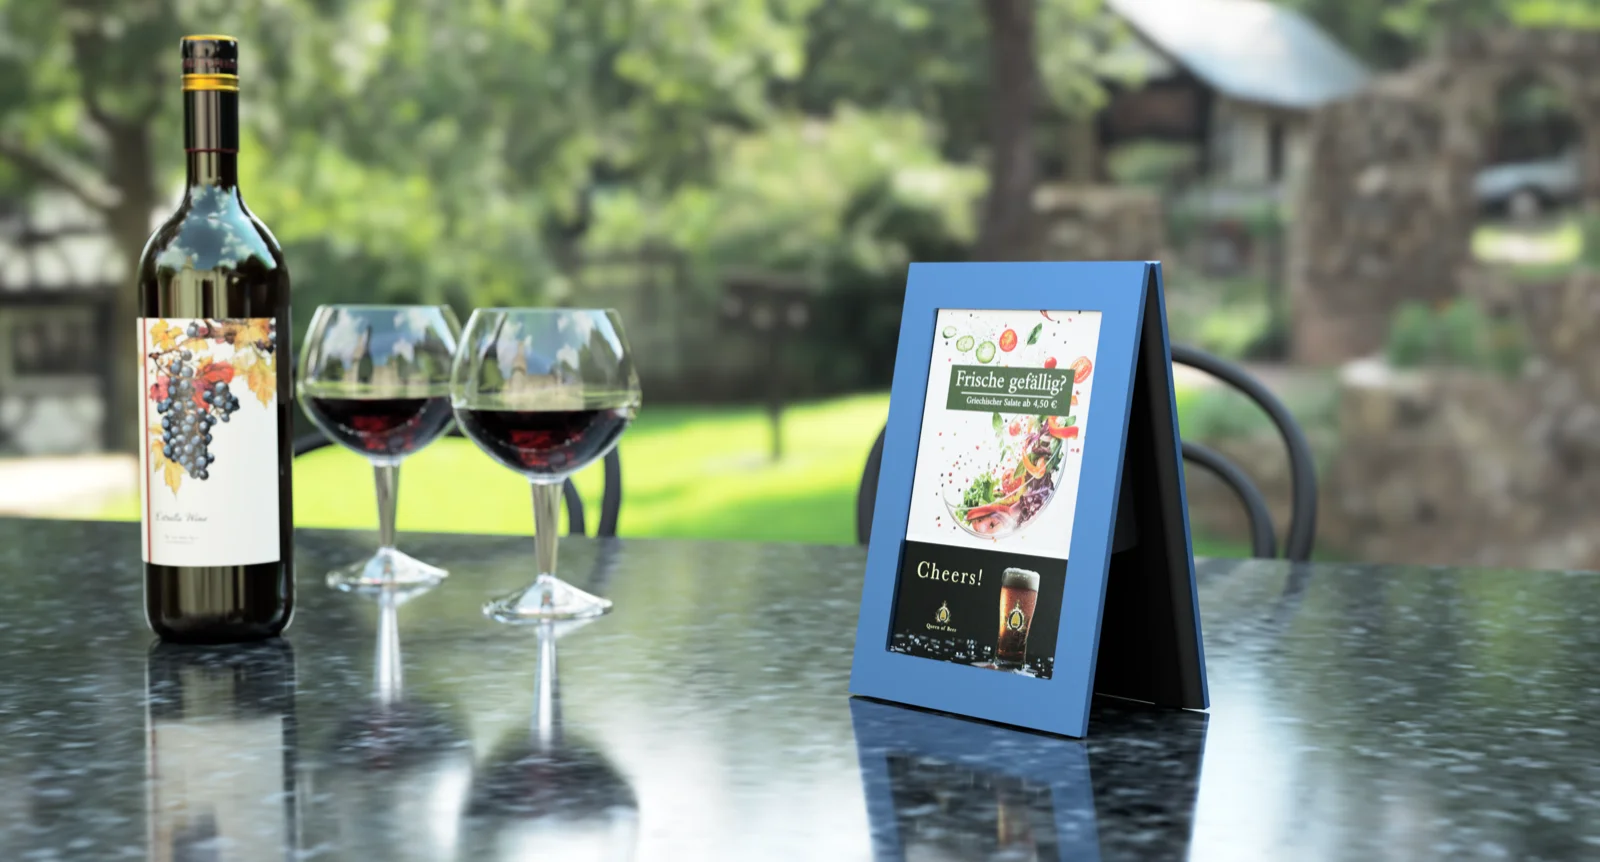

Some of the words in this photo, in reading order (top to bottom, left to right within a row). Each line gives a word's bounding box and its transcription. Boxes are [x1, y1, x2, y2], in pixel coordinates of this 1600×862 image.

[956, 370, 1005, 388] Frische
[1008, 372, 1067, 396] gefällig?
[966, 396, 1002, 406] Griechischer
[1004, 398, 1021, 407] Salate
[1022, 399, 1031, 408] ab
[1033, 399, 1049, 410] 4,50
[1051, 400, 1058, 409] €
[917, 560, 983, 586] Cheers!
[926, 622, 940, 630] Queen
